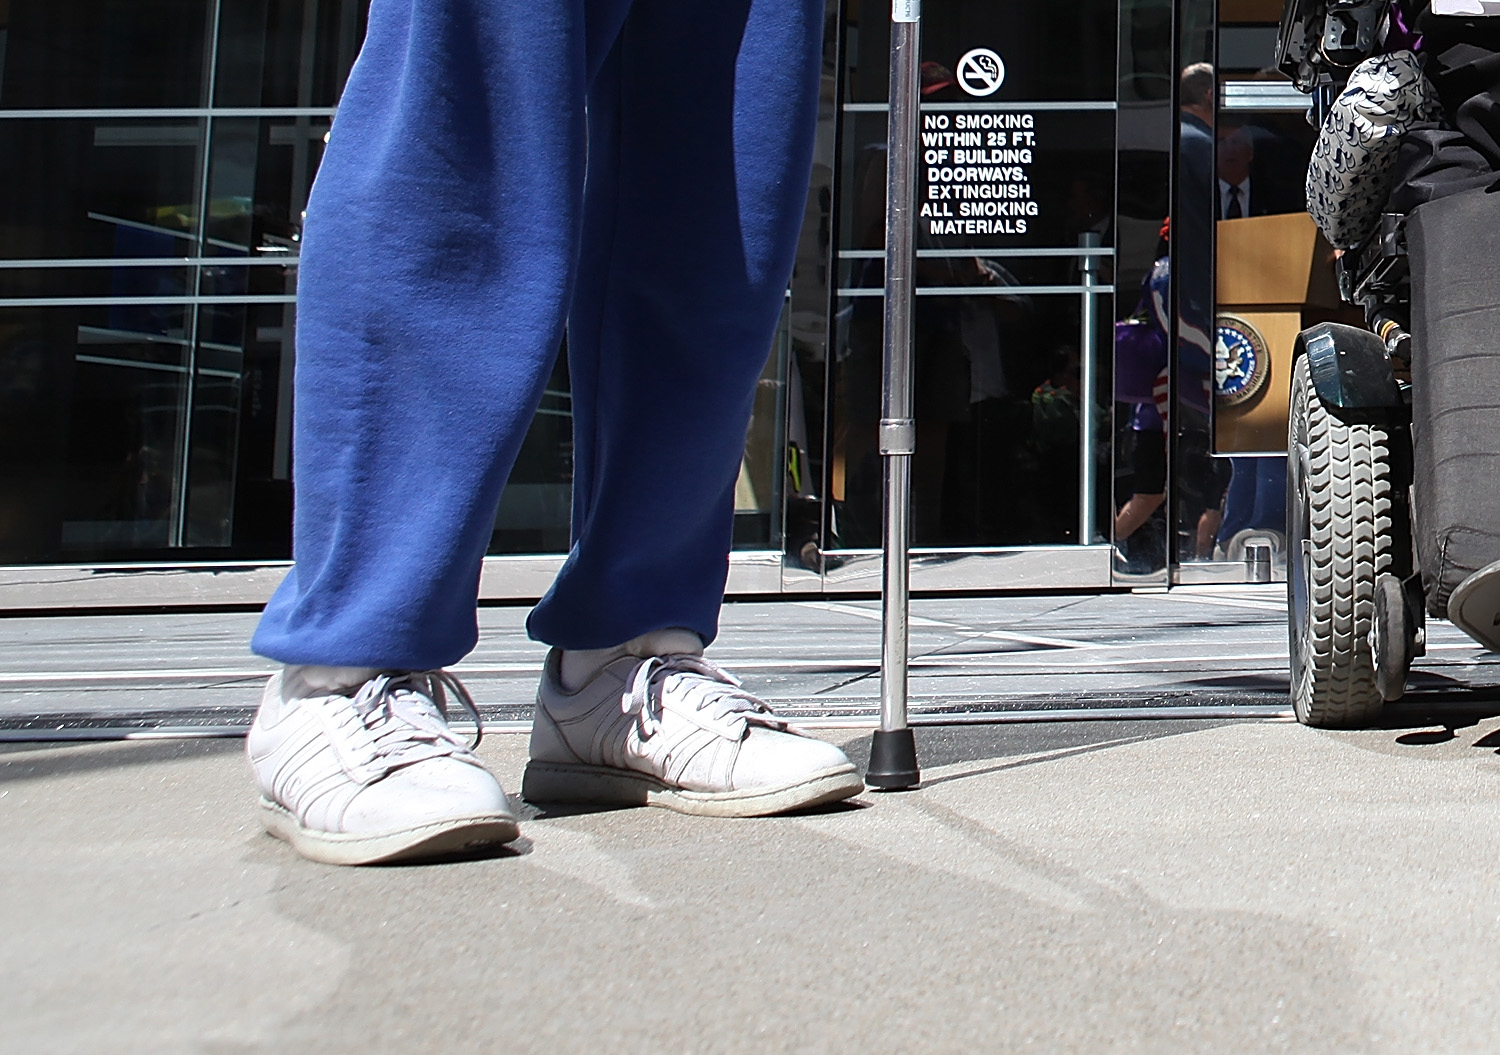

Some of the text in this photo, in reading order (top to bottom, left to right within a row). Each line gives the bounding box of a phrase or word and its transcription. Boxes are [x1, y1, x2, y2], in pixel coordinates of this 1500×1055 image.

[924, 114, 1034, 130] NO SMOKING
[921, 132, 1036, 147] WITHIN 25 FT.
[924, 149, 1032, 165] OF BUILDING
[927, 167, 1028, 182] DOORWAYS.
[928, 184, 1031, 199] EXTINGUISH
[920, 202, 1039, 217] ALL SMOKING
[930, 219, 1027, 234] MATERIALS
